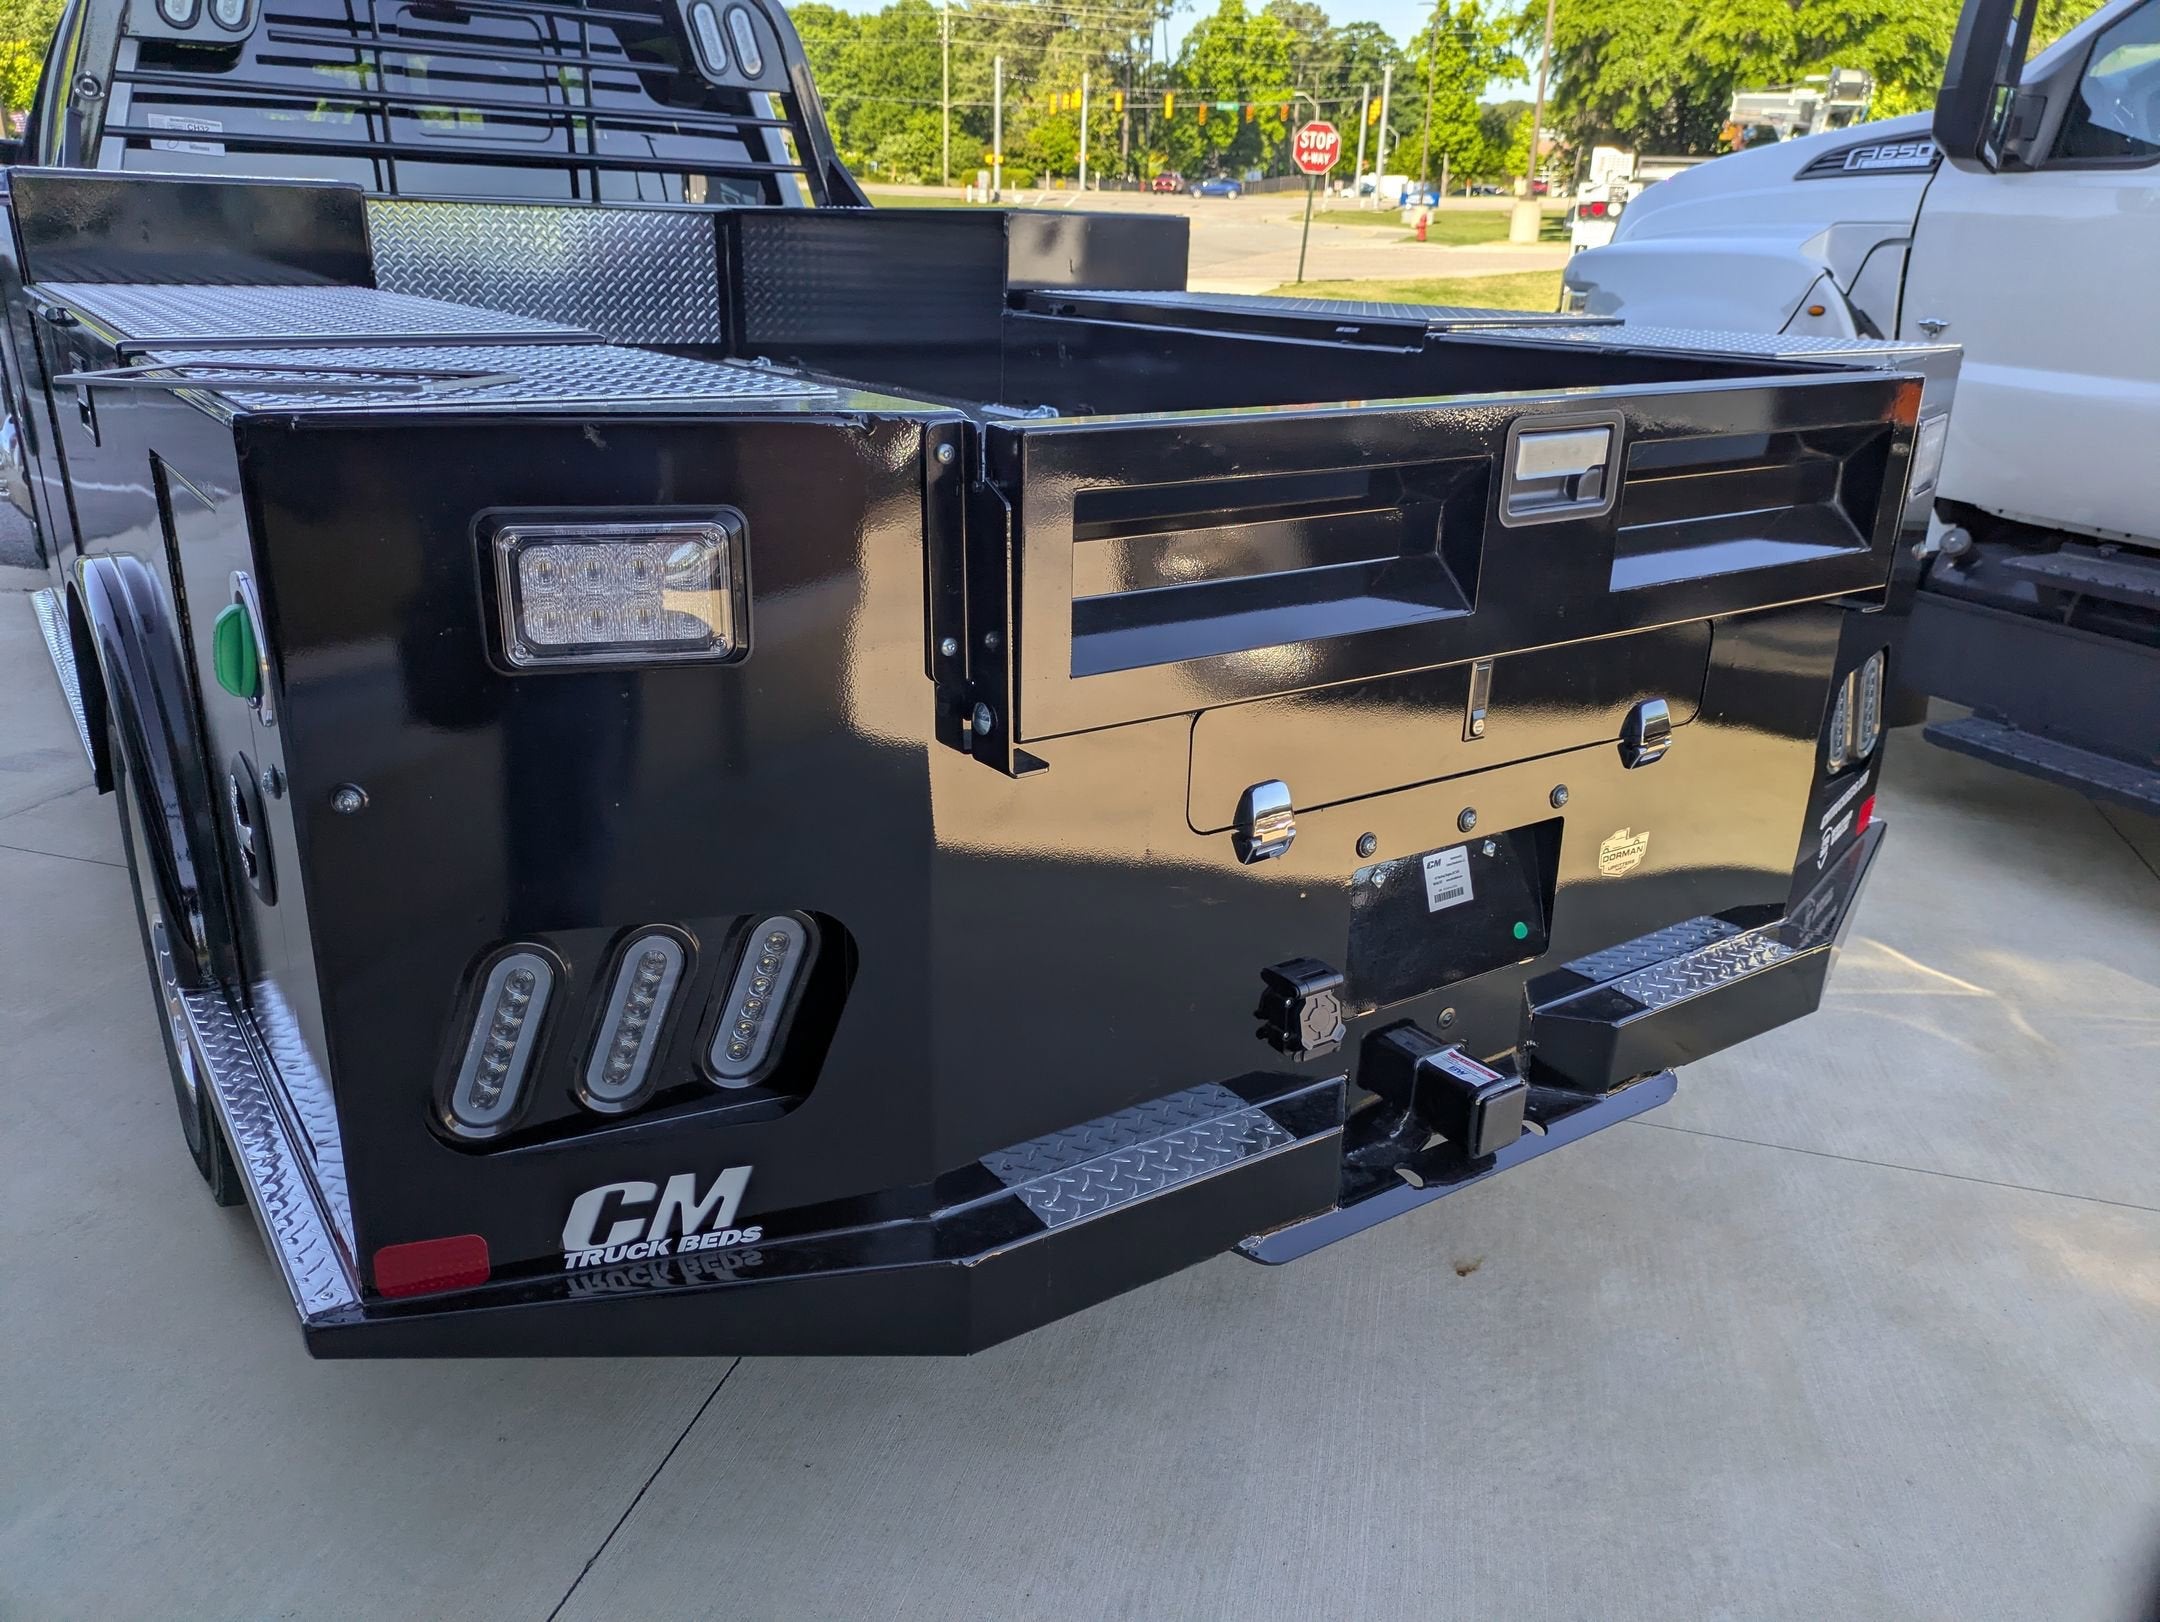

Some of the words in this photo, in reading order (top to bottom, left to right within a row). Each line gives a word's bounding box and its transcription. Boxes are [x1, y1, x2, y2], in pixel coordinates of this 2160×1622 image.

[1300, 130, 1337, 150] STOP
[1301, 151, 1332, 165] 4-WAY
[1426, 858, 1441, 869] CM
[1602, 845, 1644, 863] DORMAN
[562, 1165, 753, 1251] CM
[564, 1239, 673, 1270] TRUCK
[677, 1226, 764, 1254] BEDS
